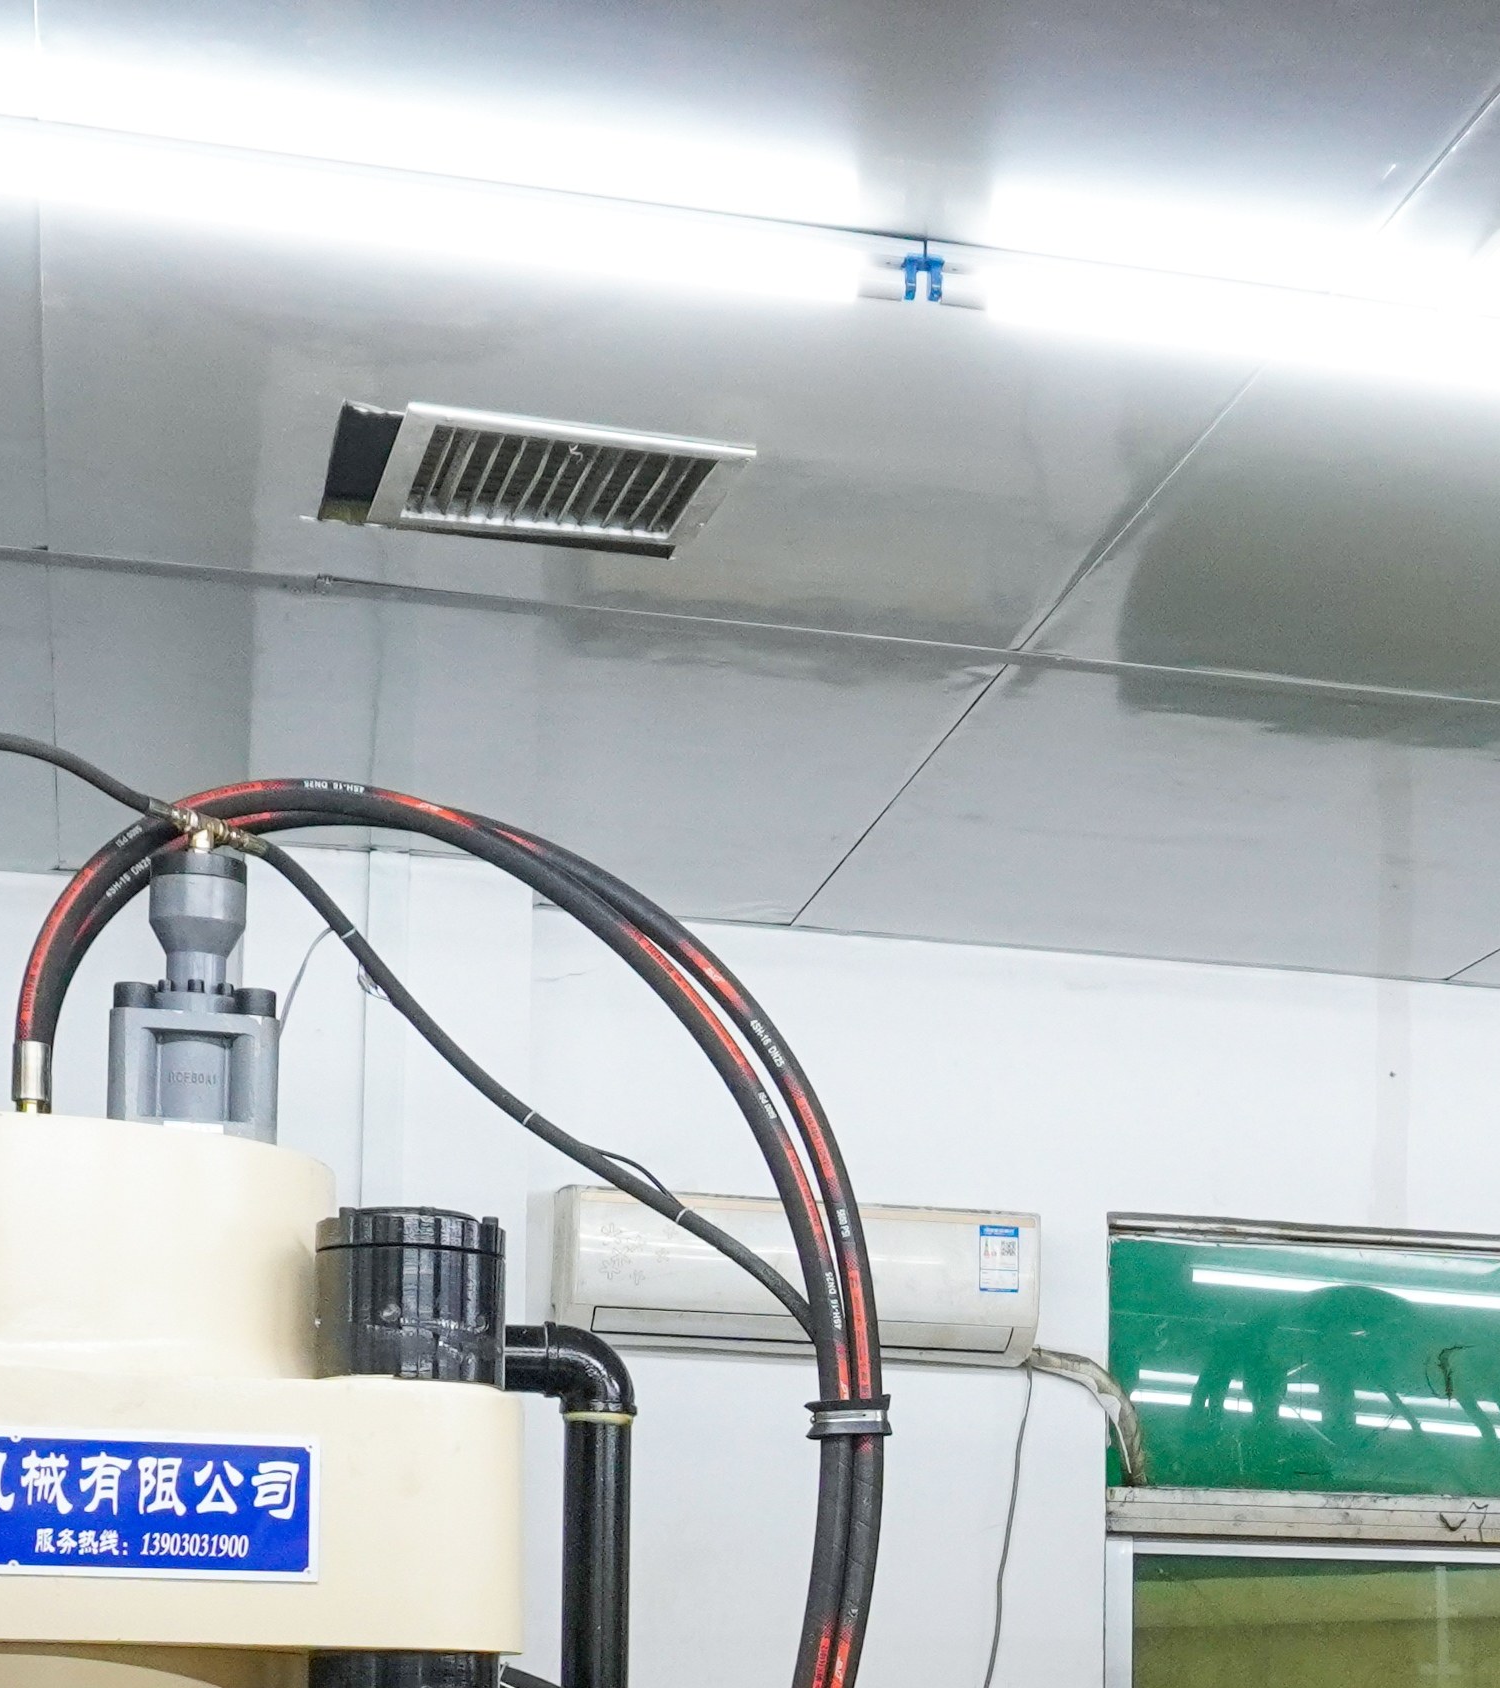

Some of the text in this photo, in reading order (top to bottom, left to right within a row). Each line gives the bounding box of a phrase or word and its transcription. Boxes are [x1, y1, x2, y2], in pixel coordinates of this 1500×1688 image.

[750, 1019, 785, 1068] 4SH-16 DN25
[824, 1271, 837, 1295] DN25
